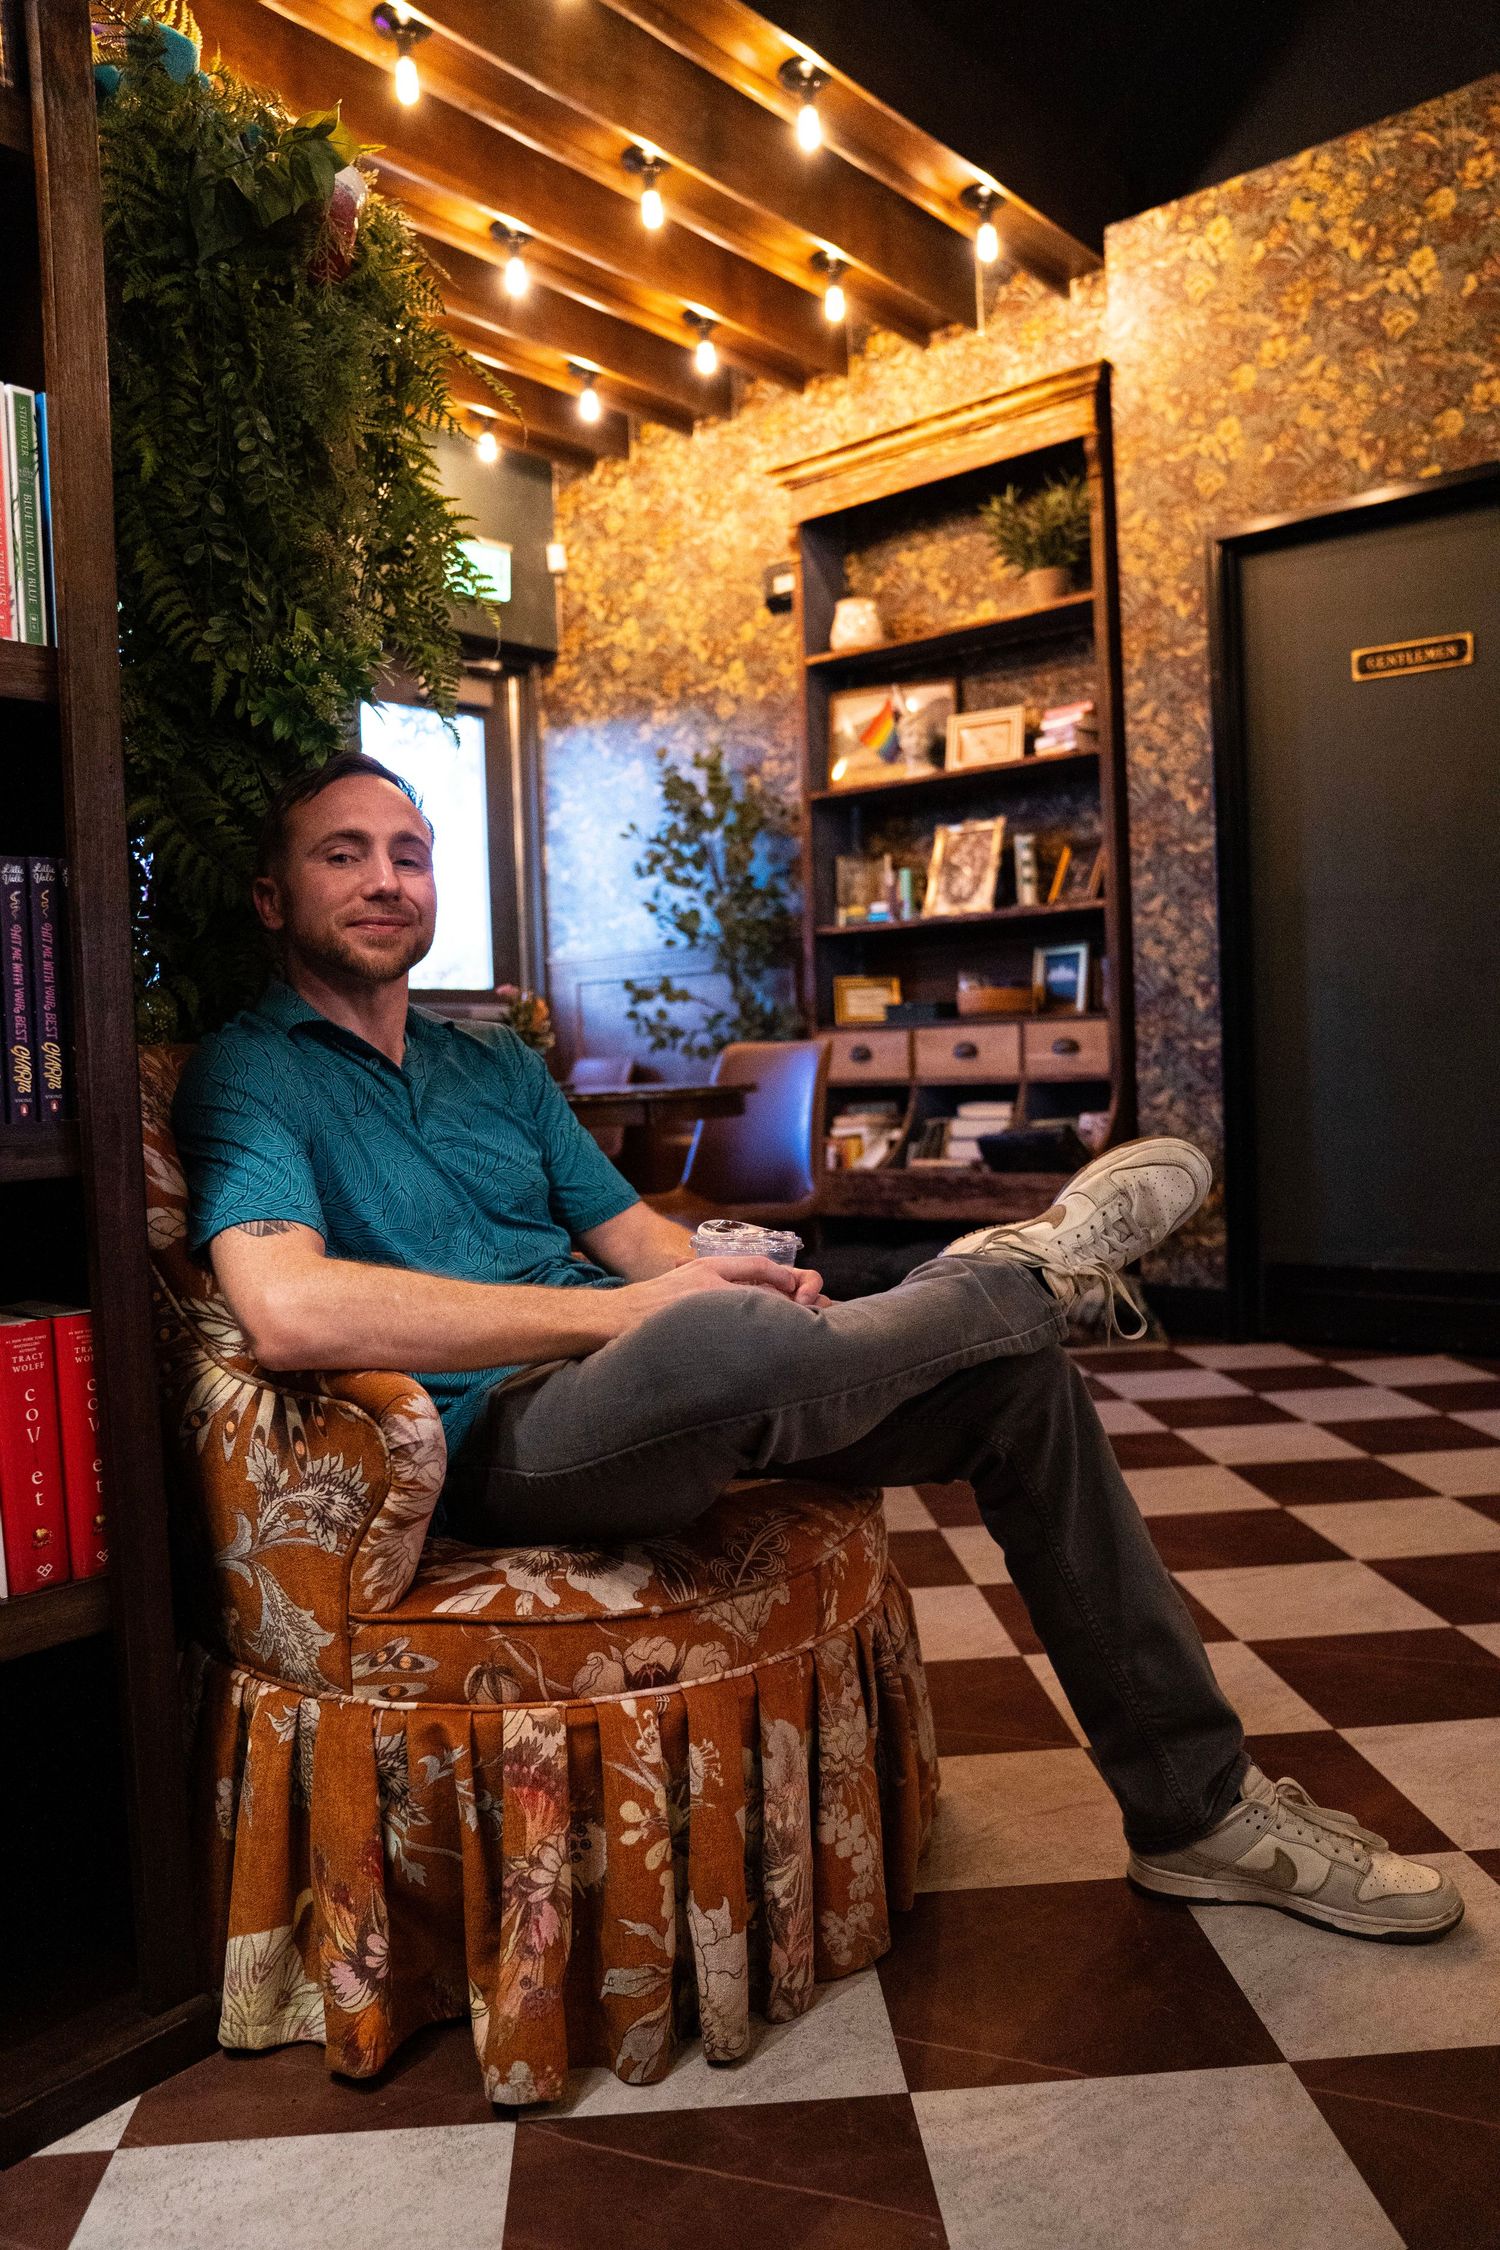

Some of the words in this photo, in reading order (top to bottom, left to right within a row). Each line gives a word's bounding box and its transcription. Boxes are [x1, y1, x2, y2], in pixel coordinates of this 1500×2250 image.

[20, 406, 29, 456] STIEFVATER
[23, 493, 33, 521] BLUE
[27, 551, 37, 574] LILY
[28, 577, 38, 605] BLUE
[10, 923, 22, 947] HIT
[41, 922, 53, 945] HIT
[11, 946, 23, 961] ME
[42, 944, 53, 960] ME
[12, 962, 24, 986] WITH
[43, 960, 55, 983] WITH
[13, 986, 26, 1014] YOUR
[43, 984, 56, 1011] YOUR
[15, 1015, 28, 1043] BEST
[45, 1012, 58, 1040] BEST
[10, 1044, 33, 1094] CHARM
[41, 1041, 63, 1090] CHARM
[12, 1351, 44, 1364] TRACY
[73, 1345, 94, 1355] TRA
[12, 1361, 45, 1373] WOLFF
